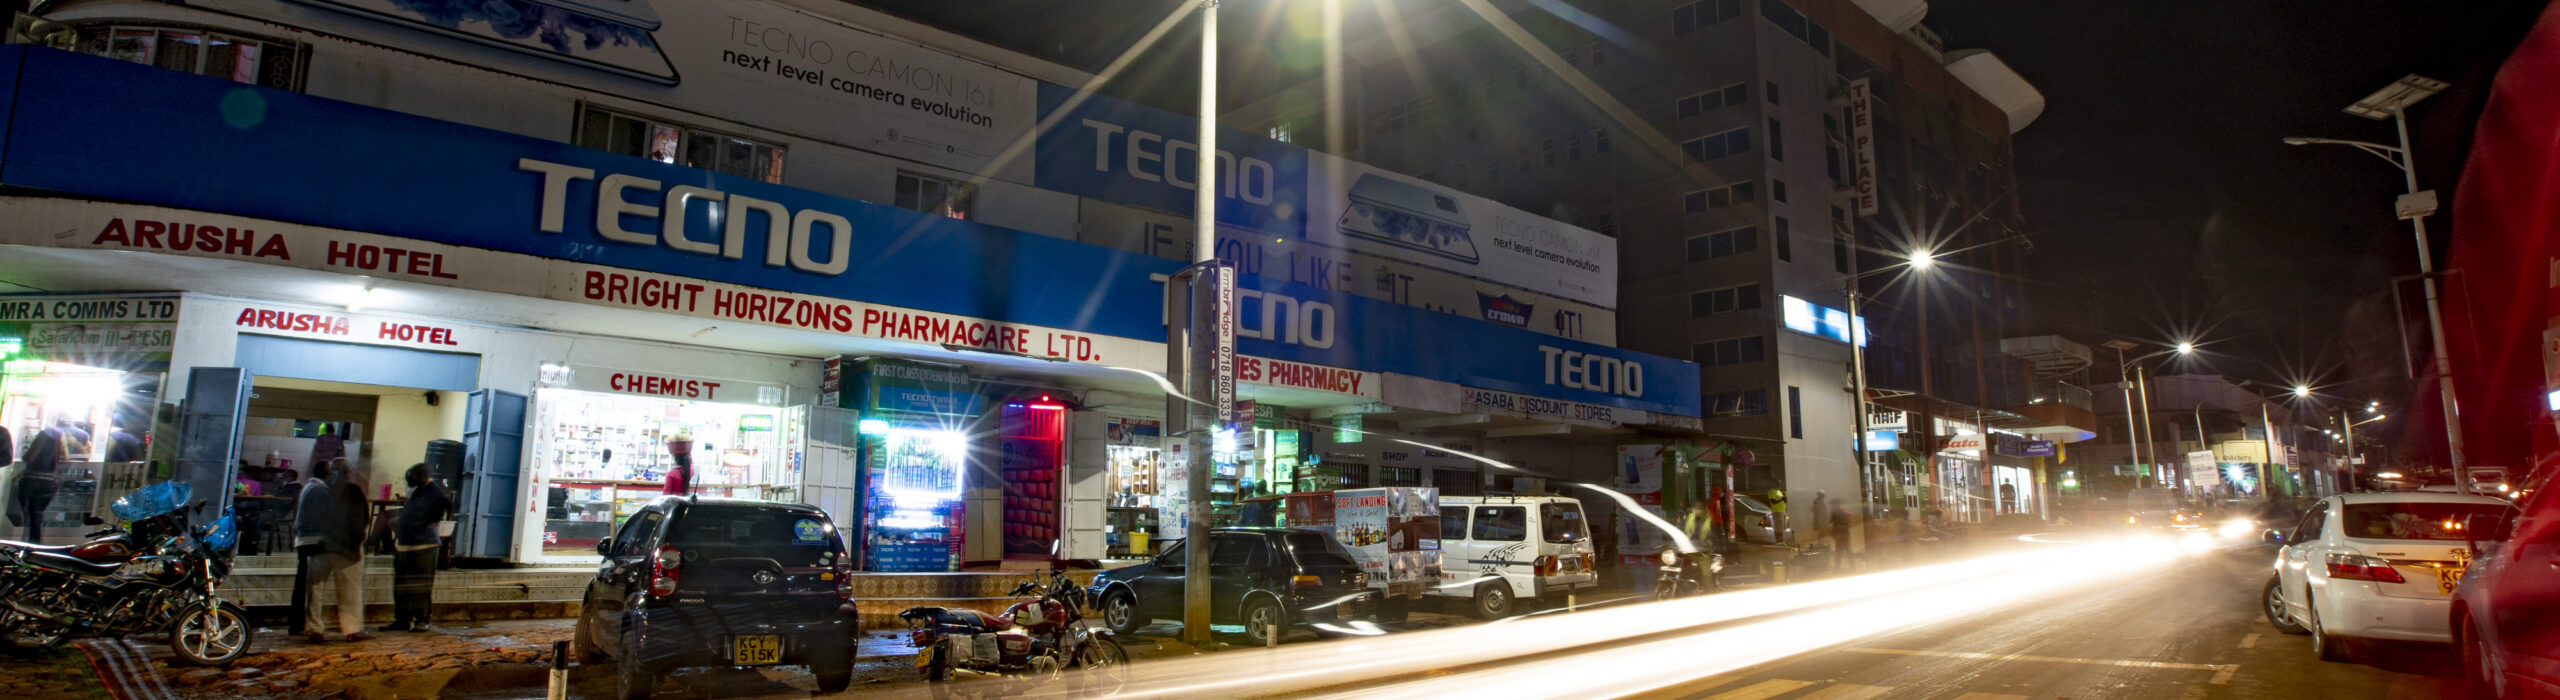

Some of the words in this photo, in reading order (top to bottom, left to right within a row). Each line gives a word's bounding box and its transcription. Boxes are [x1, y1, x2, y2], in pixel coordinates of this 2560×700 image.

[726, 15, 834, 65] TECNO
[845, 49, 954, 98] CAMON
[722, 48, 771, 73] next
[776, 58, 824, 87] level
[829, 75, 905, 107] camera
[910, 96, 993, 129] evolution
[1853, 85, 1867, 127] THE
[1857, 136, 1873, 209] PLACE
[518, 157, 853, 276] TECNO
[92, 217, 291, 260] ARUSHA
[326, 239, 458, 280] HOTEL
[1144, 220, 1174, 257] IF
[1493, 237, 1513, 251] next
[1514, 241, 1533, 257] level
[1535, 249, 1565, 265] camera
[1566, 257, 1600, 274] evolution
[52, 300, 129, 321] COMMS
[135, 300, 176, 320] LTD
[236, 307, 350, 336] ARUSHA
[377, 321, 459, 346] HOTEL
[584, 270, 704, 313] BRIGHT
[713, 288, 853, 333] HORIZONS
[862, 307, 1030, 355] PHARMACARE
[1047, 332, 1101, 363] LTD.
[872, 363, 898, 378] FIRST
[897, 366, 920, 380] CLASS
[1220, 346, 1231, 373] 0718
[1537, 344, 1643, 398] TECNO
[610, 372, 722, 400] CHEMIST
[1220, 375, 1230, 395] 860
[1268, 360, 1365, 396] PHARMACY.
[1219, 398, 1229, 418] 333
[1464, 390, 1515, 410] MASABA
[1519, 396, 1569, 418] DISCOUNT
[1382, 451, 1409, 462] SHOP
[1336, 496, 1354, 510] SOFT
[1355, 495, 1387, 509] LANDING
[740, 637, 766, 649] KCY
[740, 648, 776, 662] 515K
